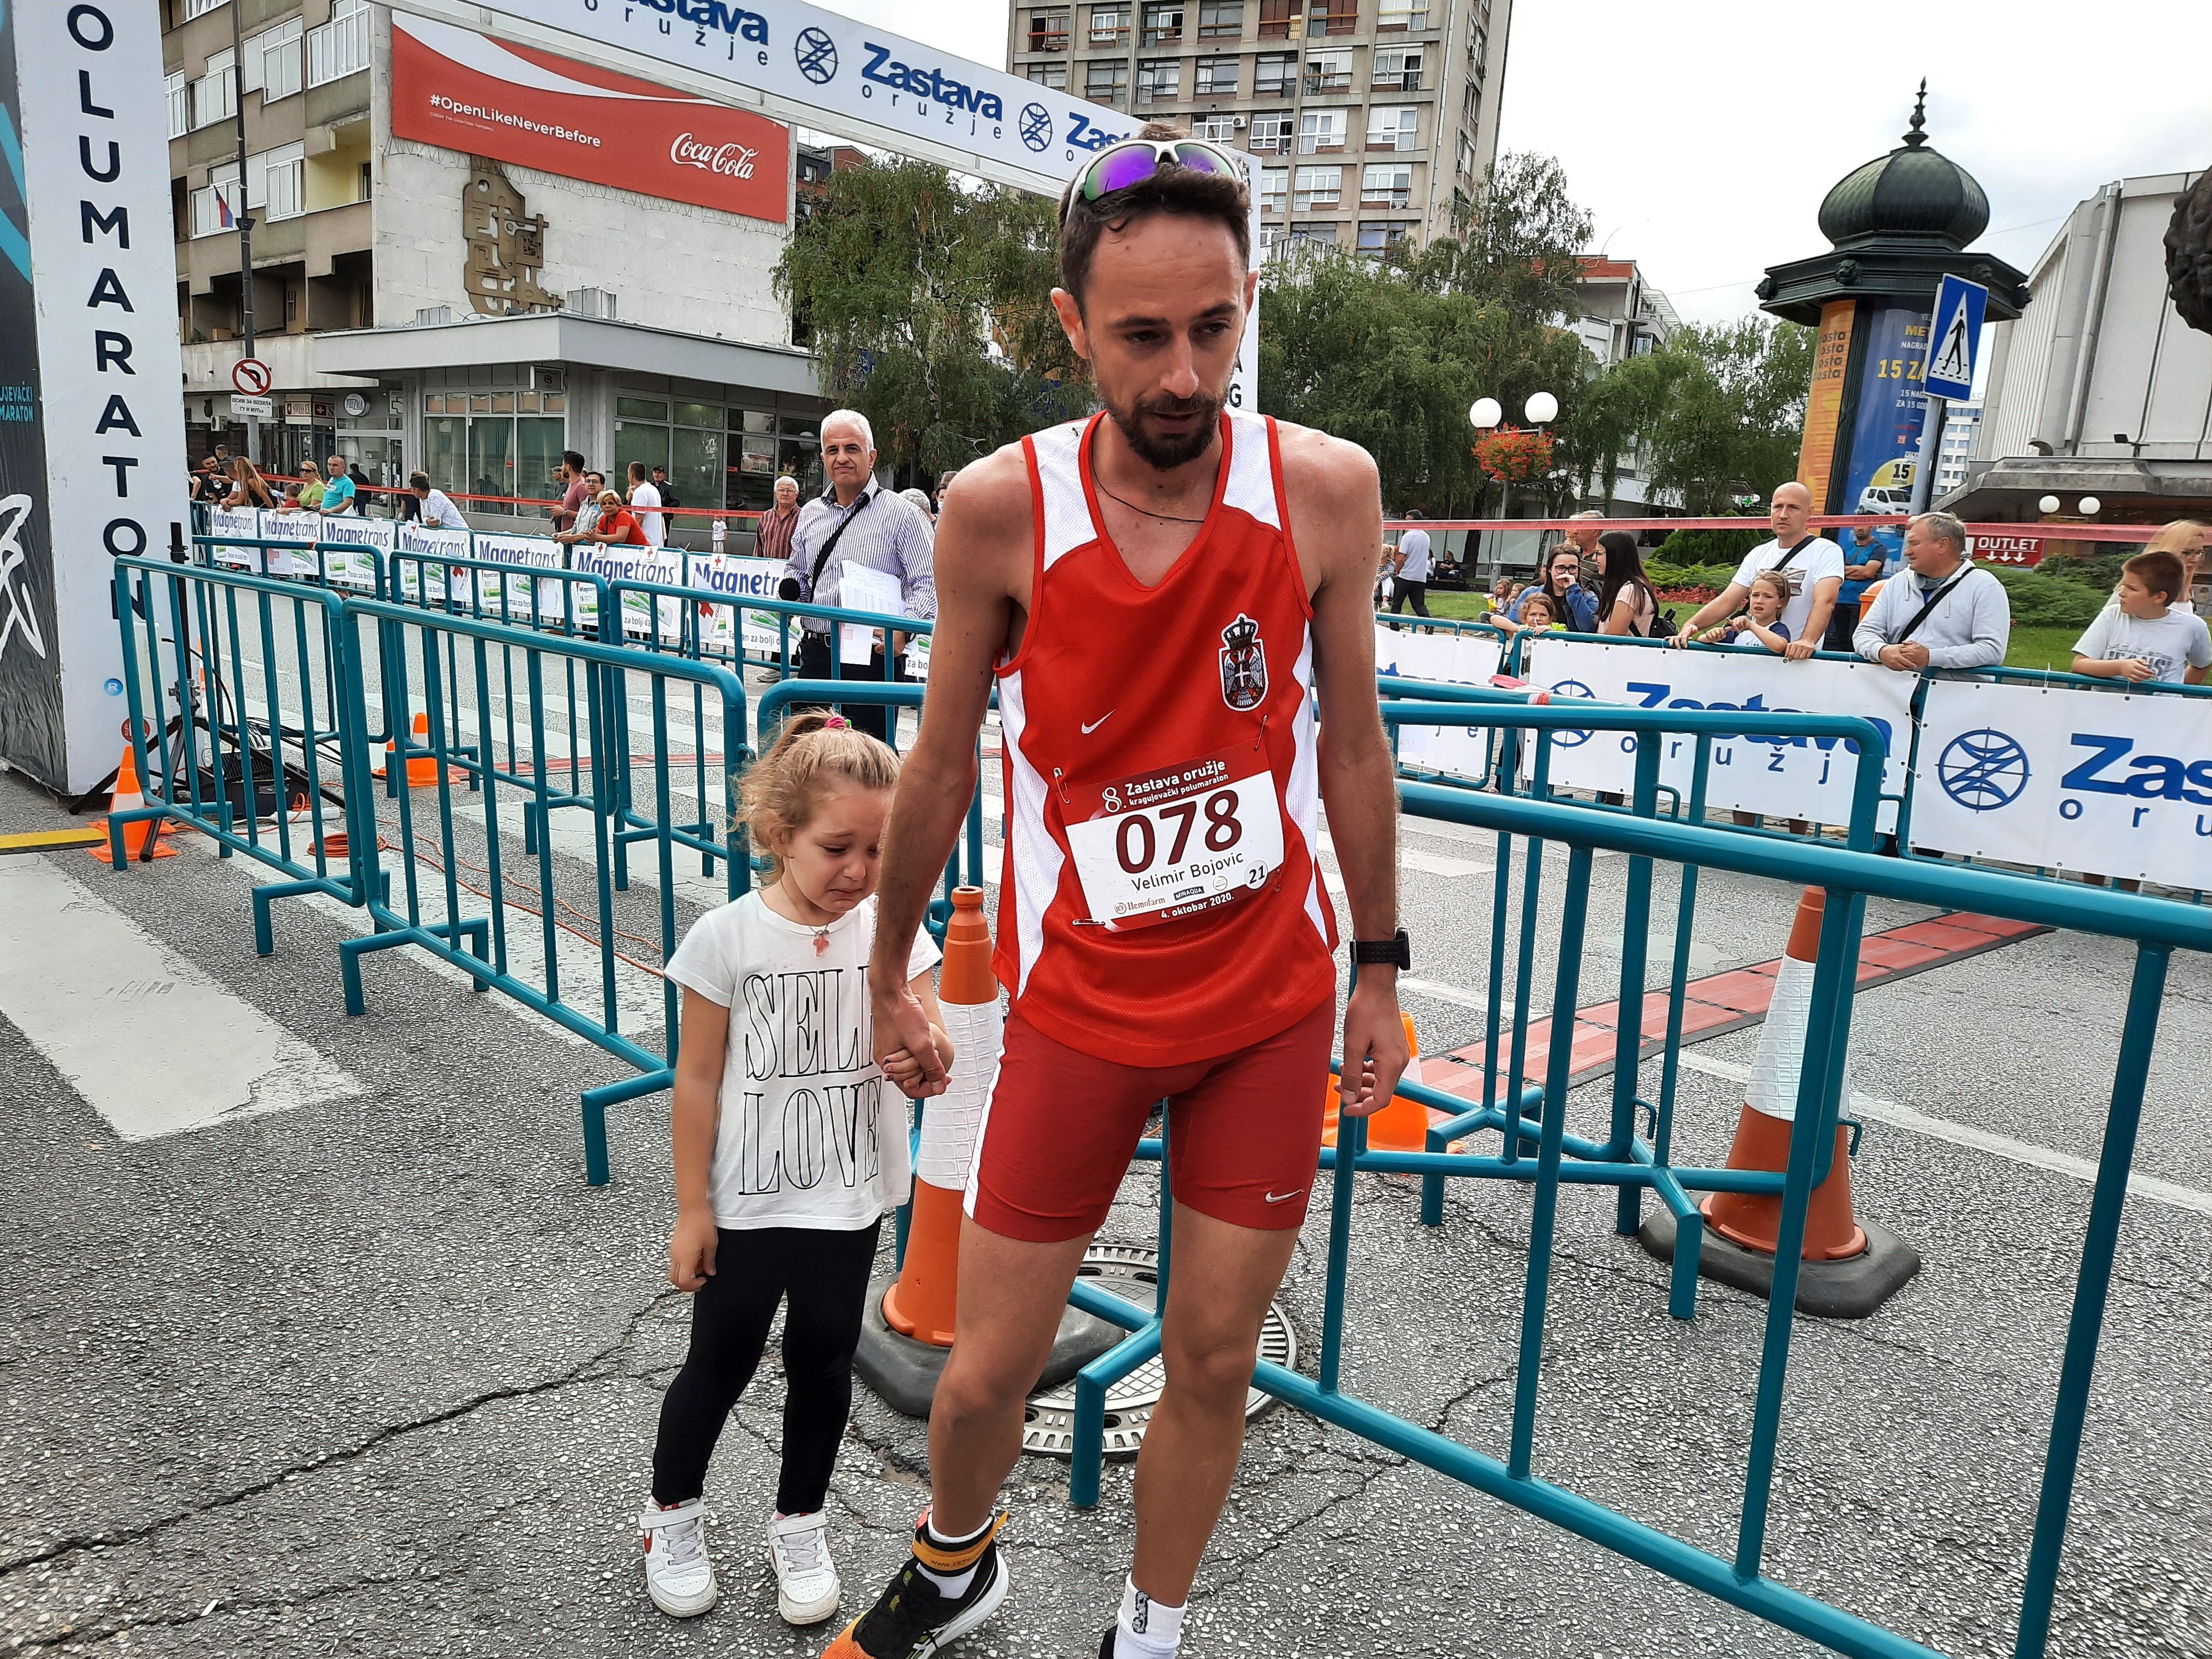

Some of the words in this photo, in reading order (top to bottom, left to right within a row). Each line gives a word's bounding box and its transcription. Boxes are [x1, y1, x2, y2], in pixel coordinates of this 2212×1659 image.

[862, 41, 1003, 122] Zastava
[430, 93, 601, 148] #OpenLikeNeverBefore
[862, 84, 1003, 140] oružje
[670, 132, 760, 180] Coca-Cola
[1901, 341, 1927, 350] NAGRAD
[1878, 359, 1903, 378] 15
[1917, 401, 1927, 410] GOD
[1892, 463, 1910, 479] 15
[265, 517, 317, 539] Magnetrans
[1978, 537, 2038, 550] OUTLET
[577, 551, 675, 585] Magnetrans
[693, 562, 780, 596] Magnetr
[632, 616, 644, 627] bolji
[728, 630, 749, 641] Taan
[759, 634, 775, 646] bolji
[919, 660, 928, 669] bo
[108, 682, 119, 691] R
[1125, 775, 1180, 796] Zastava
[1183, 760, 1226, 781] oružje
[1129, 787, 1179, 806] kragujevački
[1181, 774, 1229, 795] polumaraton
[1115, 789, 1243, 874] 078
[1131, 869, 1186, 891] Velimir
[1190, 852, 1244, 878] Bojovic
[1127, 897, 1166, 911] Hemofarm
[1175, 888, 1203, 899] MINAQUA
[1249, 865, 1265, 884] 21
[1172, 902, 1208, 916] oktobar
[1209, 892, 1234, 907] 2020.
[738, 1076, 882, 1195] LOVE
